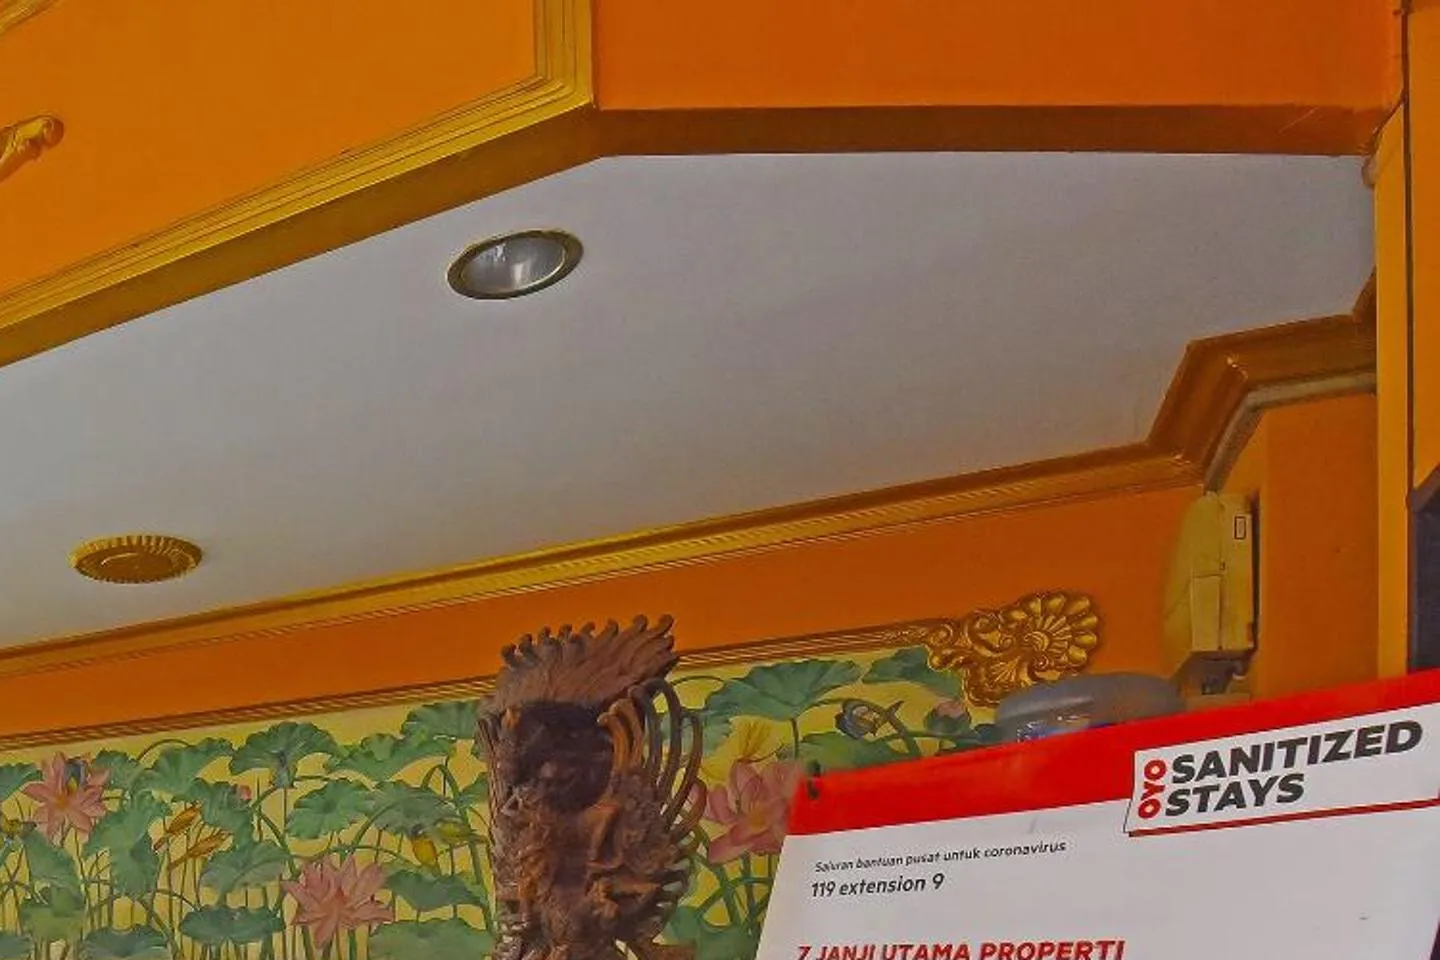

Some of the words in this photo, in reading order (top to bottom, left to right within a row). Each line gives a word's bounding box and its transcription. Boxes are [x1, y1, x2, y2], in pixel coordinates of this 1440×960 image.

[1171, 721, 1423, 785] SANITIZED
[1137, 759, 1167, 820] OYO
[1164, 772, 1305, 817] STAYS
[815, 859, 853, 873] Saluran
[856, 856, 903, 869] bantuan
[906, 851, 940, 867] pusat
[943, 847, 981, 861] untuk
[984, 840, 1067, 858] coronavirus
[811, 880, 835, 897] 119
[839, 875, 926, 896] extension
[932, 872, 945, 890] 9
